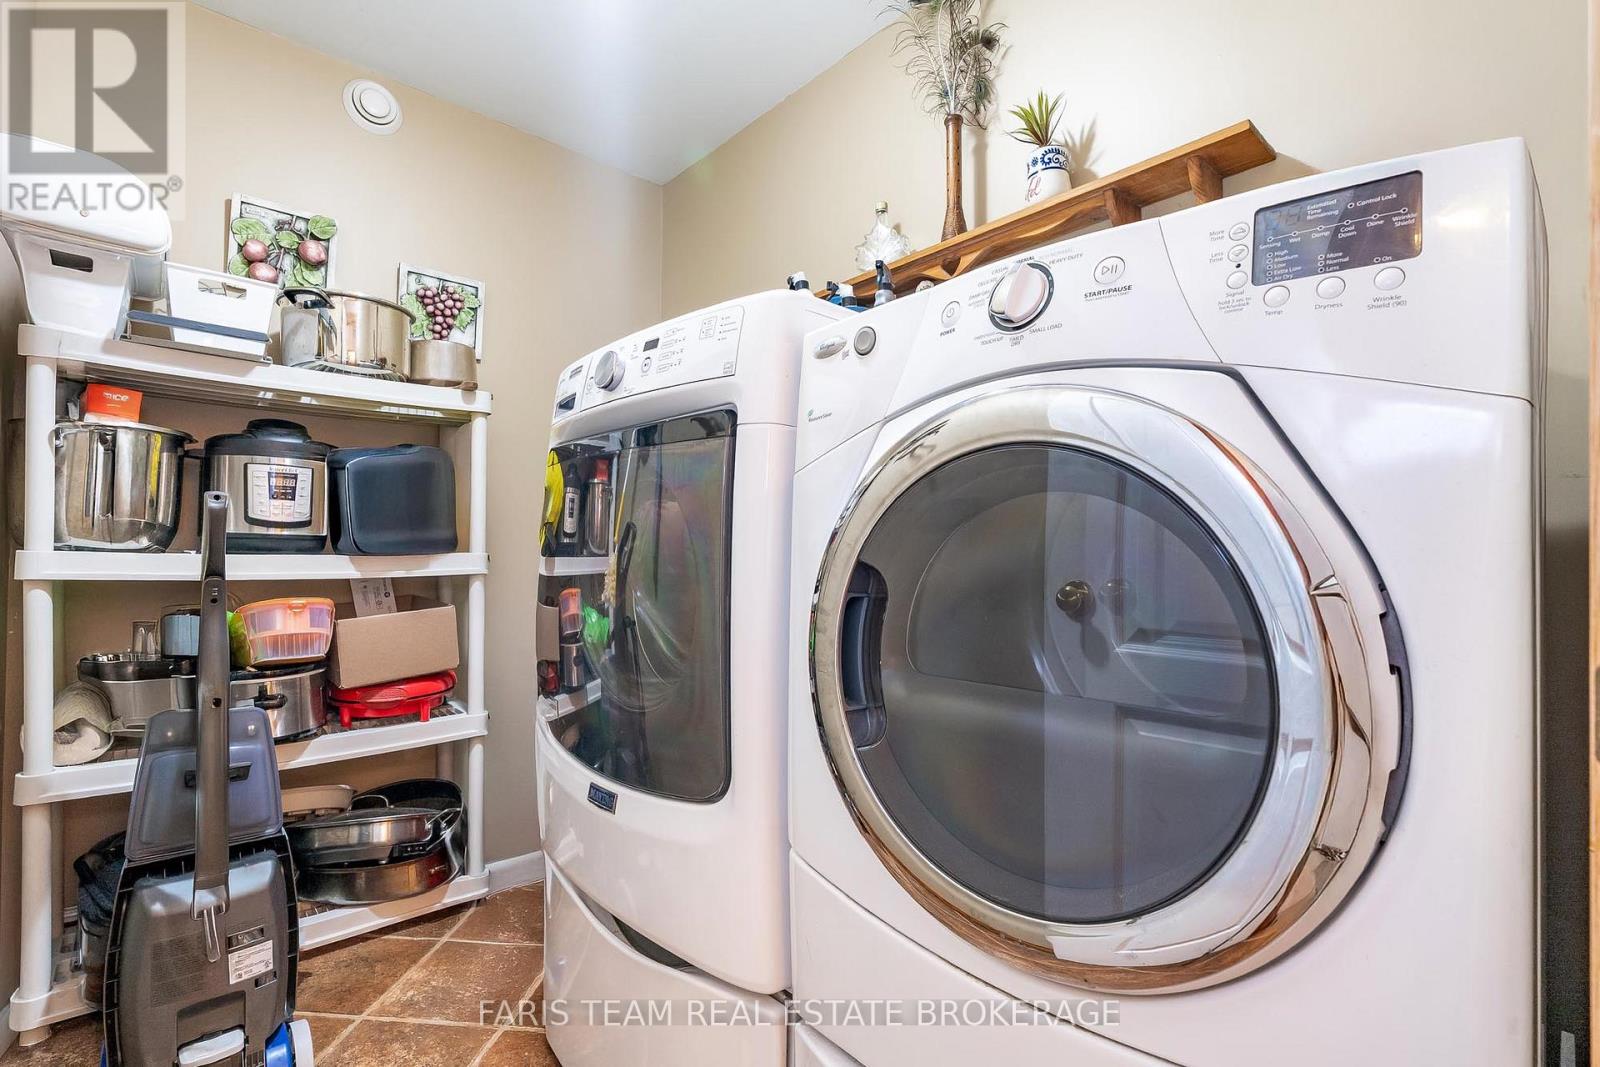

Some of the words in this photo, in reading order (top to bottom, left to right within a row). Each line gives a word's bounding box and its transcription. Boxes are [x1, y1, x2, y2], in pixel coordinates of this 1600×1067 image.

[1357, 197, 1380, 207] Control
[1382, 193, 1397, 201] Lock
[1340, 225, 1355, 233] Cool
[1338, 231, 1357, 239] Down
[1083, 284, 1133, 299] START/PAUSE
[1372, 294, 1402, 303] Wrinkle
[1314, 302, 1344, 311] Dryness
[1367, 301, 1391, 311] Shield
